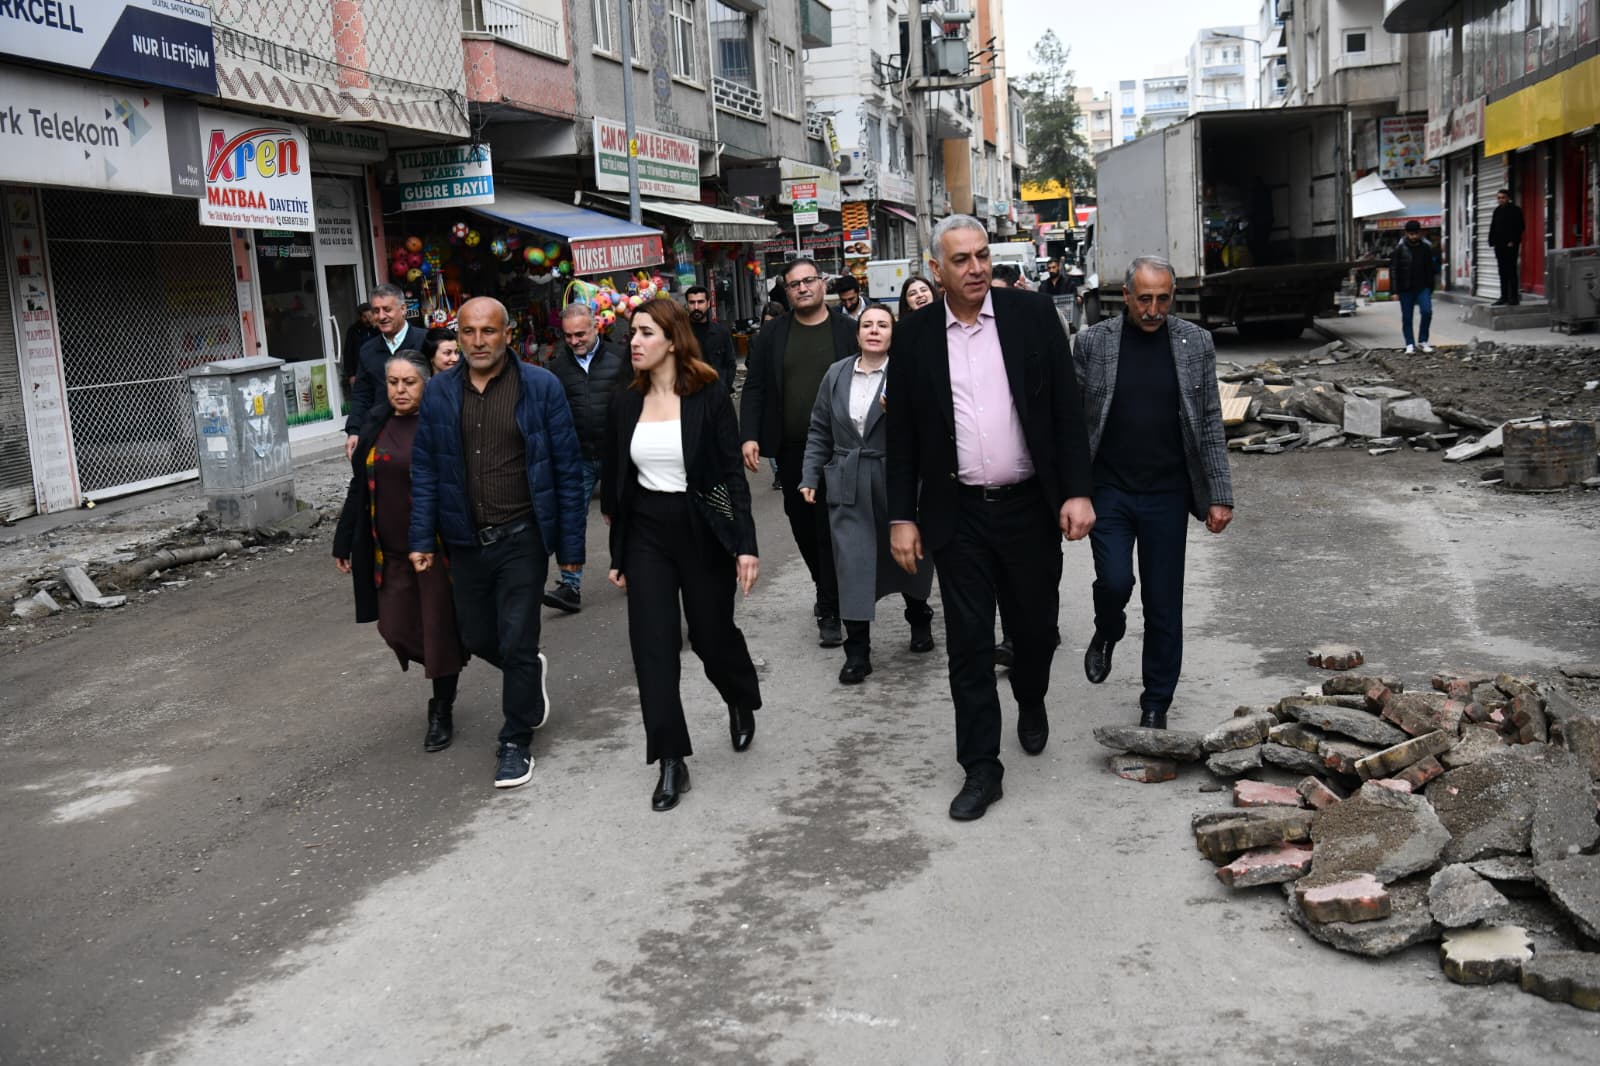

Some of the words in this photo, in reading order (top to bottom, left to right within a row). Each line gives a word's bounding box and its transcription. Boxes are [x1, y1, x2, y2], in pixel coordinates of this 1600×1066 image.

[0, 0, 83, 33] RKCELL
[132, 34, 159, 57] NUR
[162, 36, 210, 69] İLETİŞİM
[28, 108, 119, 147] Telekom
[601, 125, 617, 151] CAN
[206, 128, 300, 183] Aren
[207, 187, 267, 209] MATBAA
[269, 197, 309, 213] DAVETİYE
[404, 183, 449, 201] GÜBRE
[574, 245, 609, 271] YÜKSEL
[610, 243, 644, 267] MARKET
